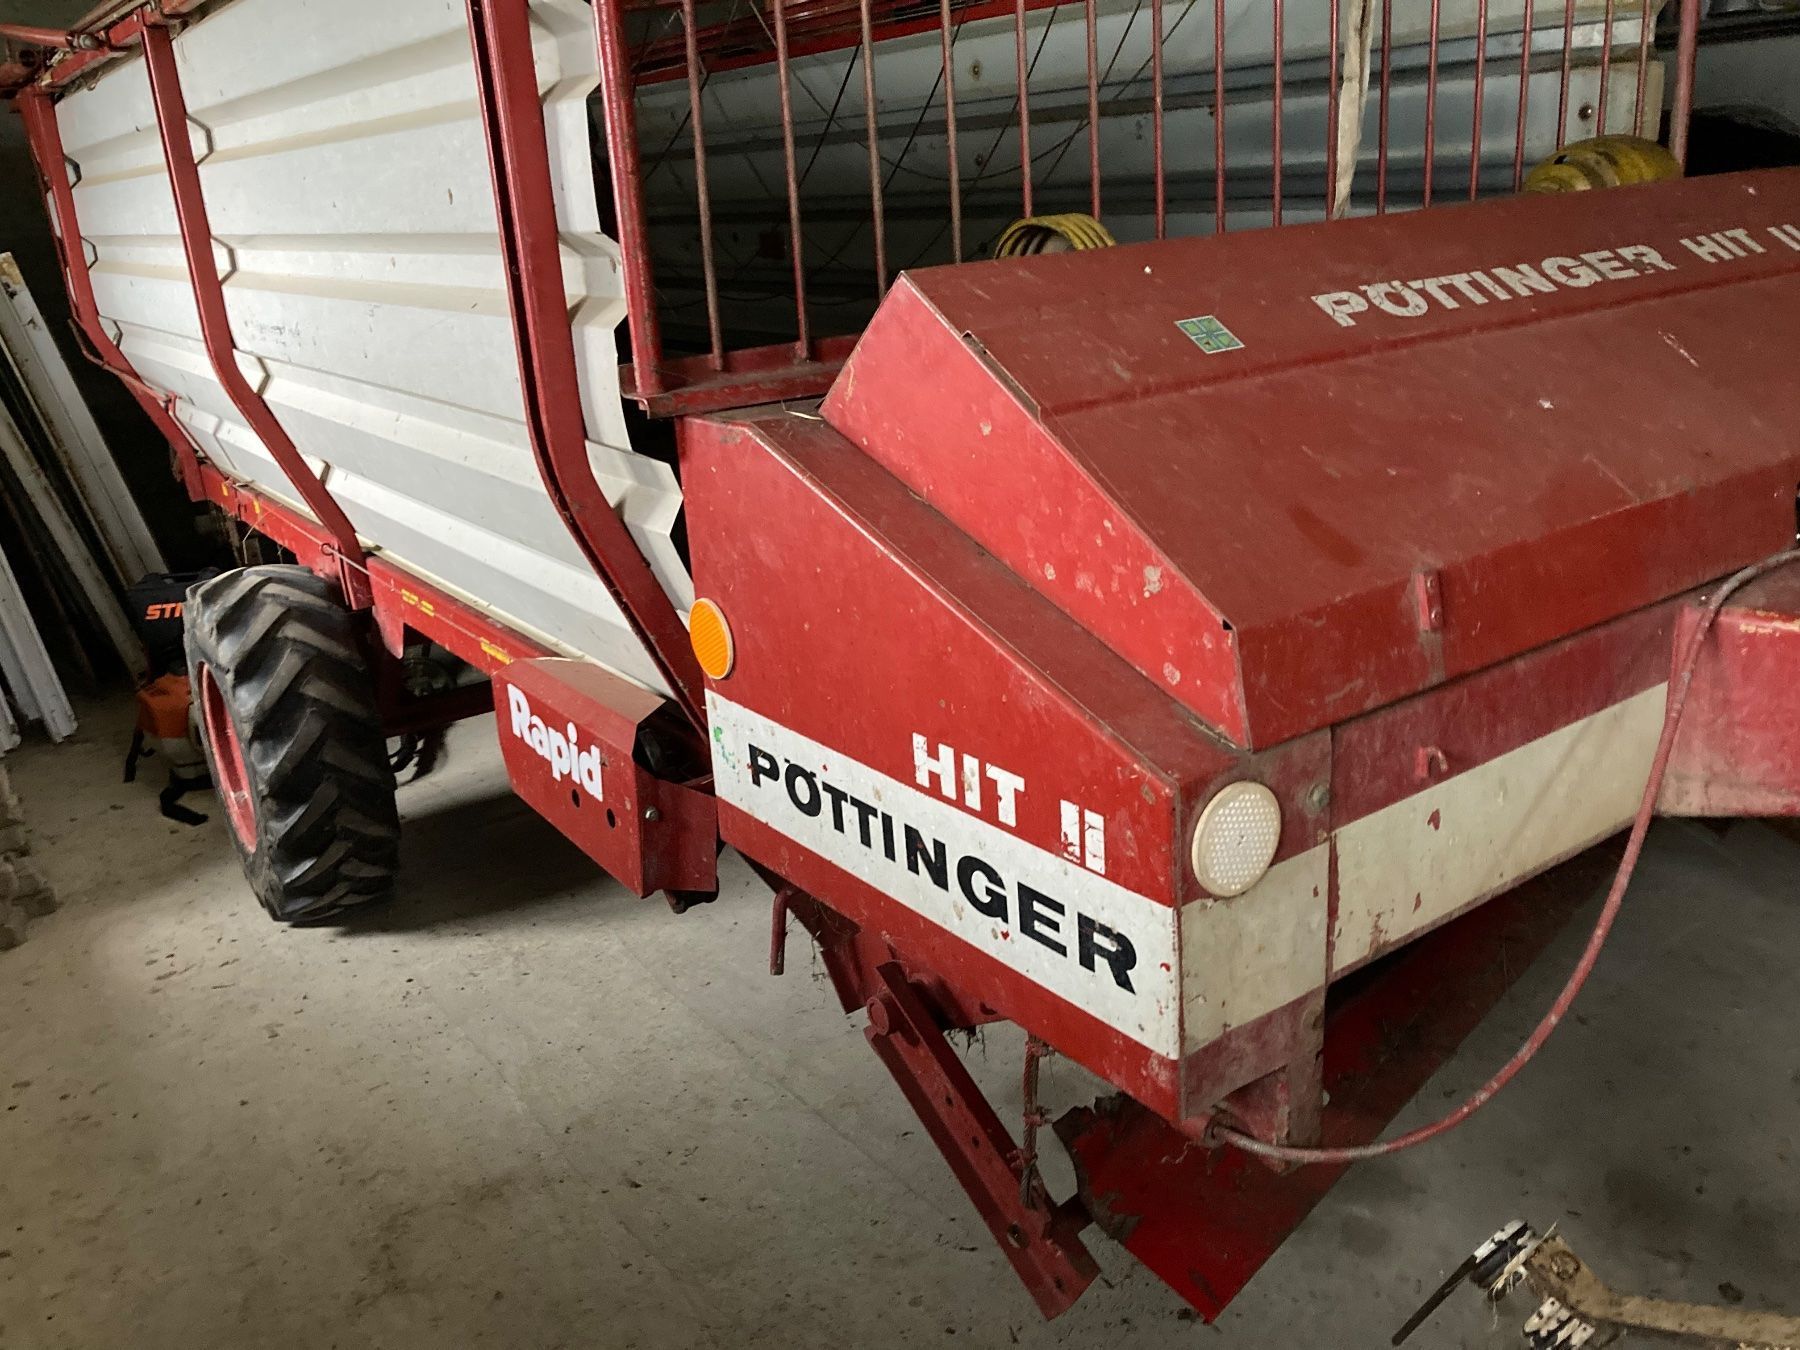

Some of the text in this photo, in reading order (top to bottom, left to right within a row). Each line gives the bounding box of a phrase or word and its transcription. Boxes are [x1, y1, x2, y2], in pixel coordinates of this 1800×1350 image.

[1311, 244, 1677, 328] PÖTTINGER
[1679, 228, 1767, 263] HIT
[144, 602, 183, 620] STI
[507, 683, 603, 802] Rapid
[912, 732, 1025, 828] HIT
[747, 743, 1138, 996] PÖTTINGER
